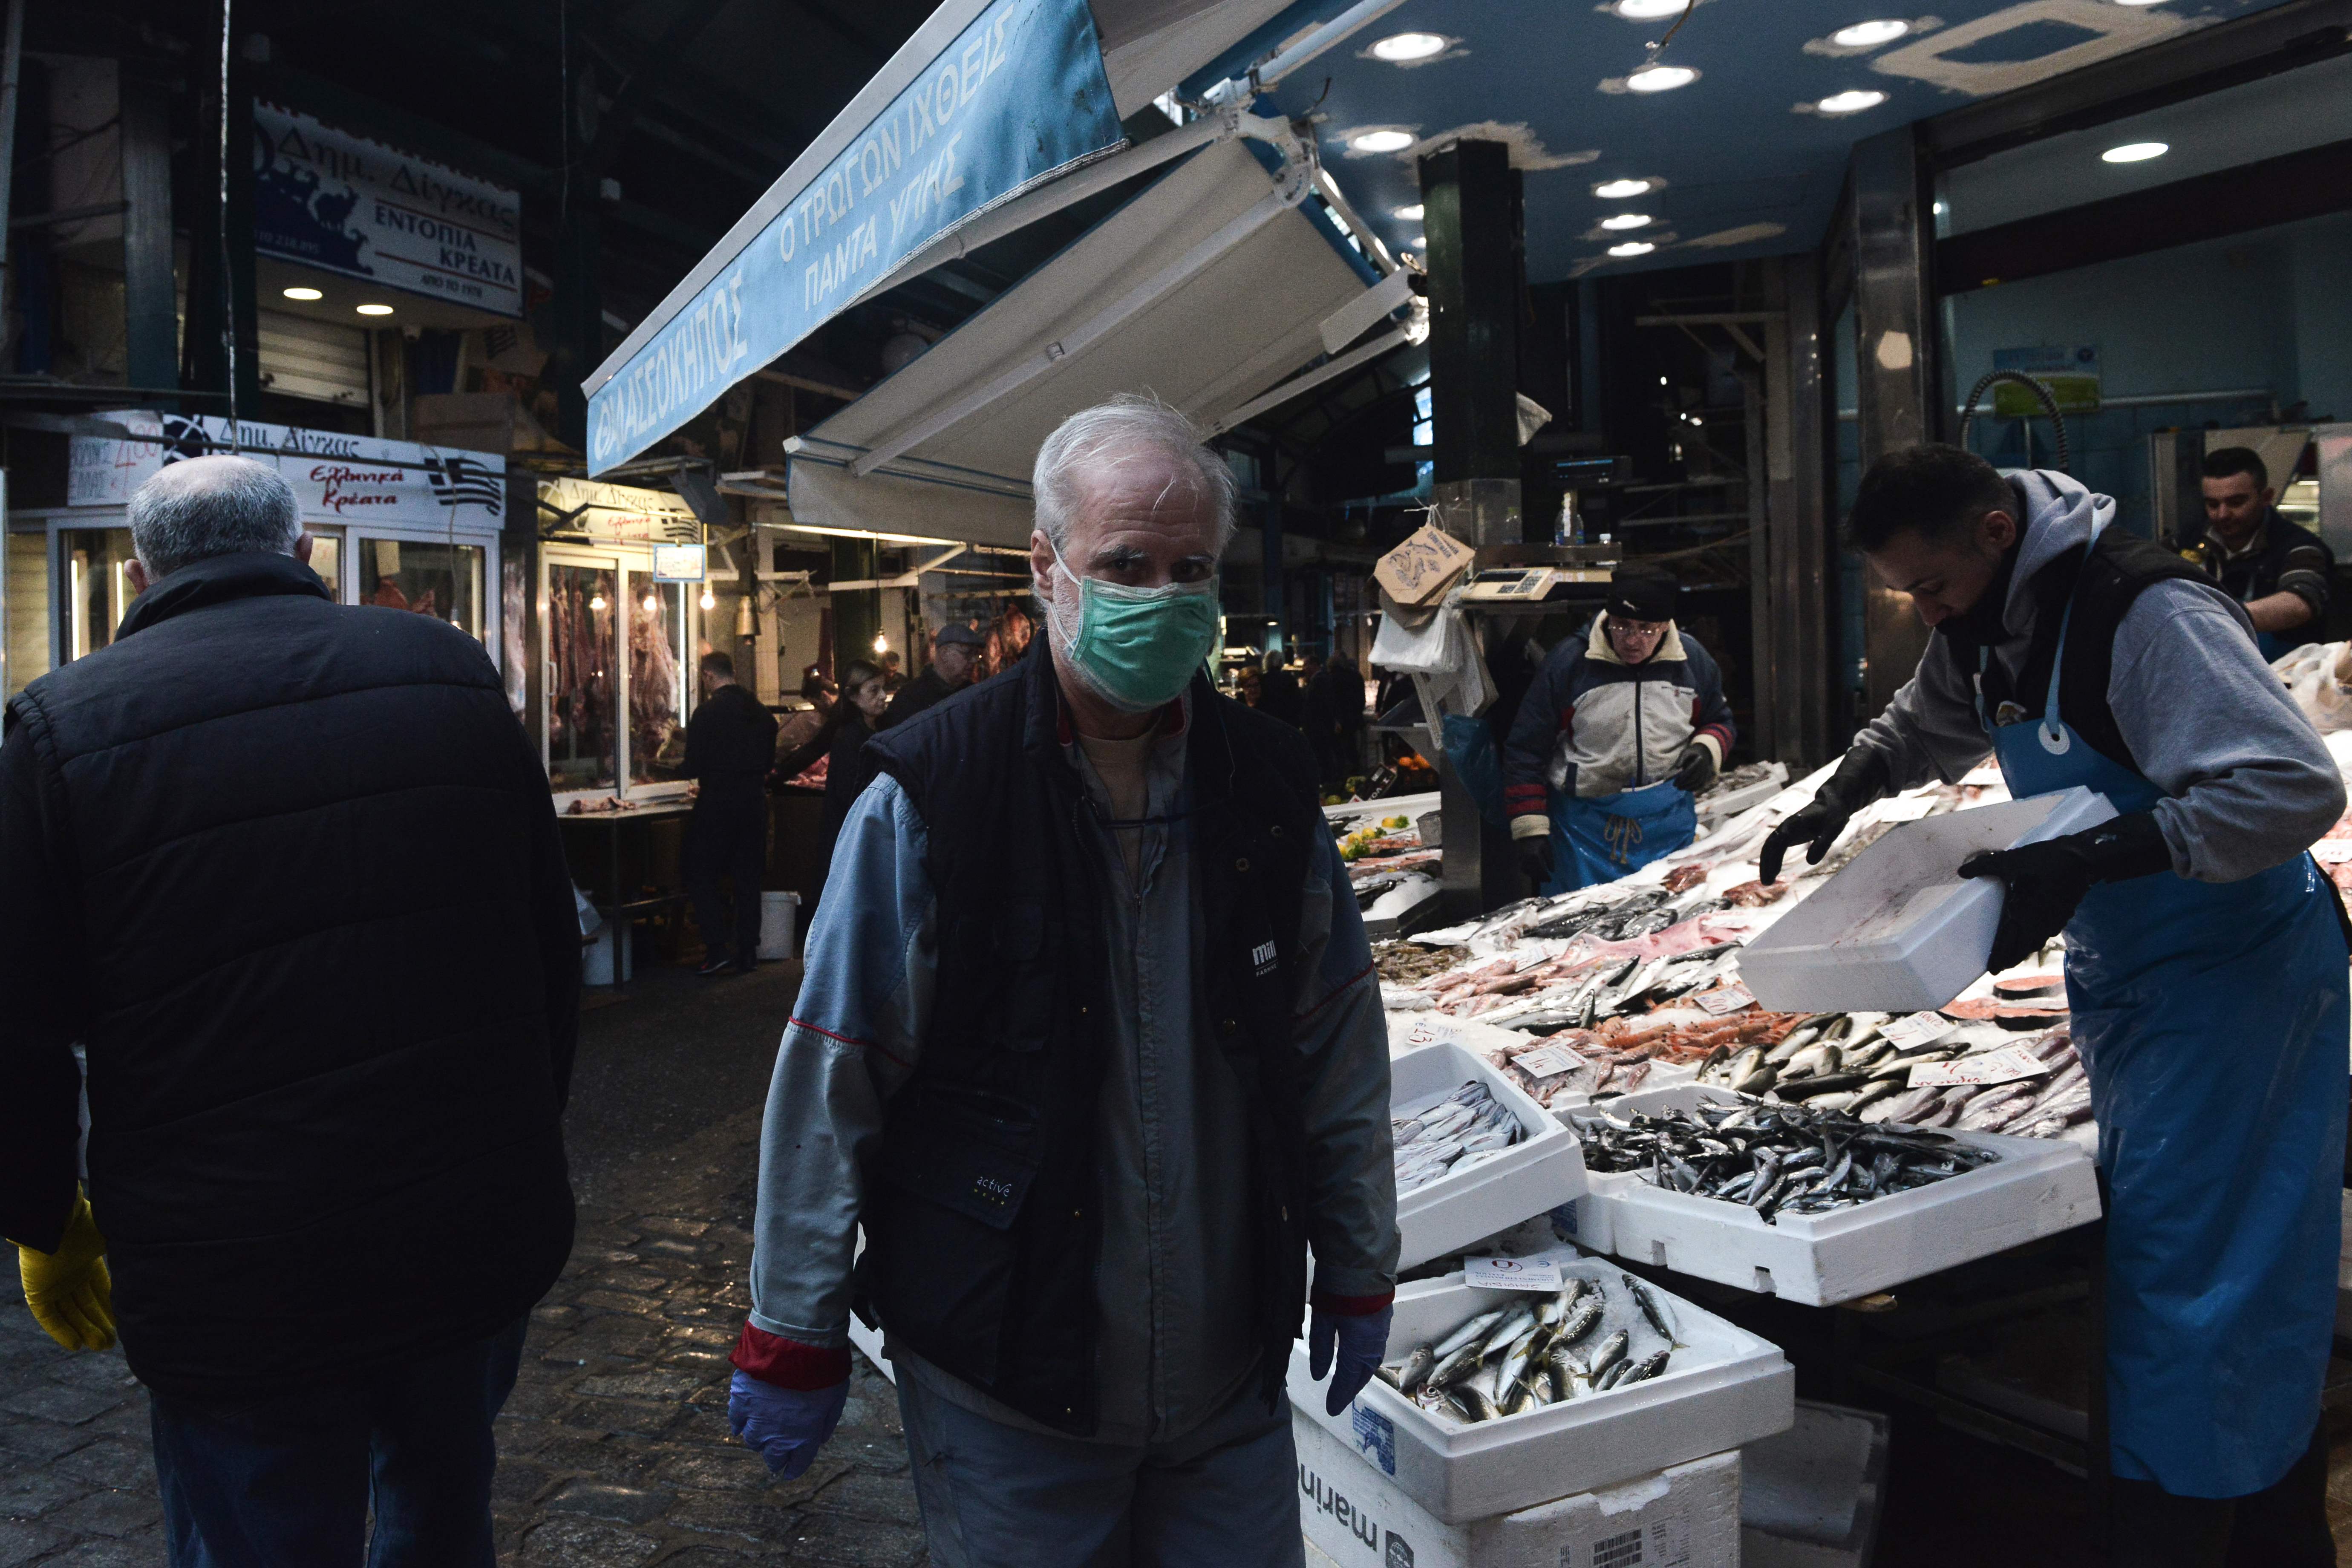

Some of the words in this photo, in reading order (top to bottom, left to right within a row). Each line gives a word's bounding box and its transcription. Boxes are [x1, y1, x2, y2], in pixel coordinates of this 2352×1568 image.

[800, 118, 901, 246] ΤΡΩΓΩΝ
[909, 3, 1014, 156] ΙΧΘΕΙΣ
[375, 205, 476, 251] ΕΝΤΟΠΙΑ
[440, 248, 515, 285] ΚΡΕΑΤΑ
[805, 214, 877, 312] ΠΑΝΤΑ
[323, 490, 398, 514] Κρέατα
[977, 1176, 1012, 1197] active
